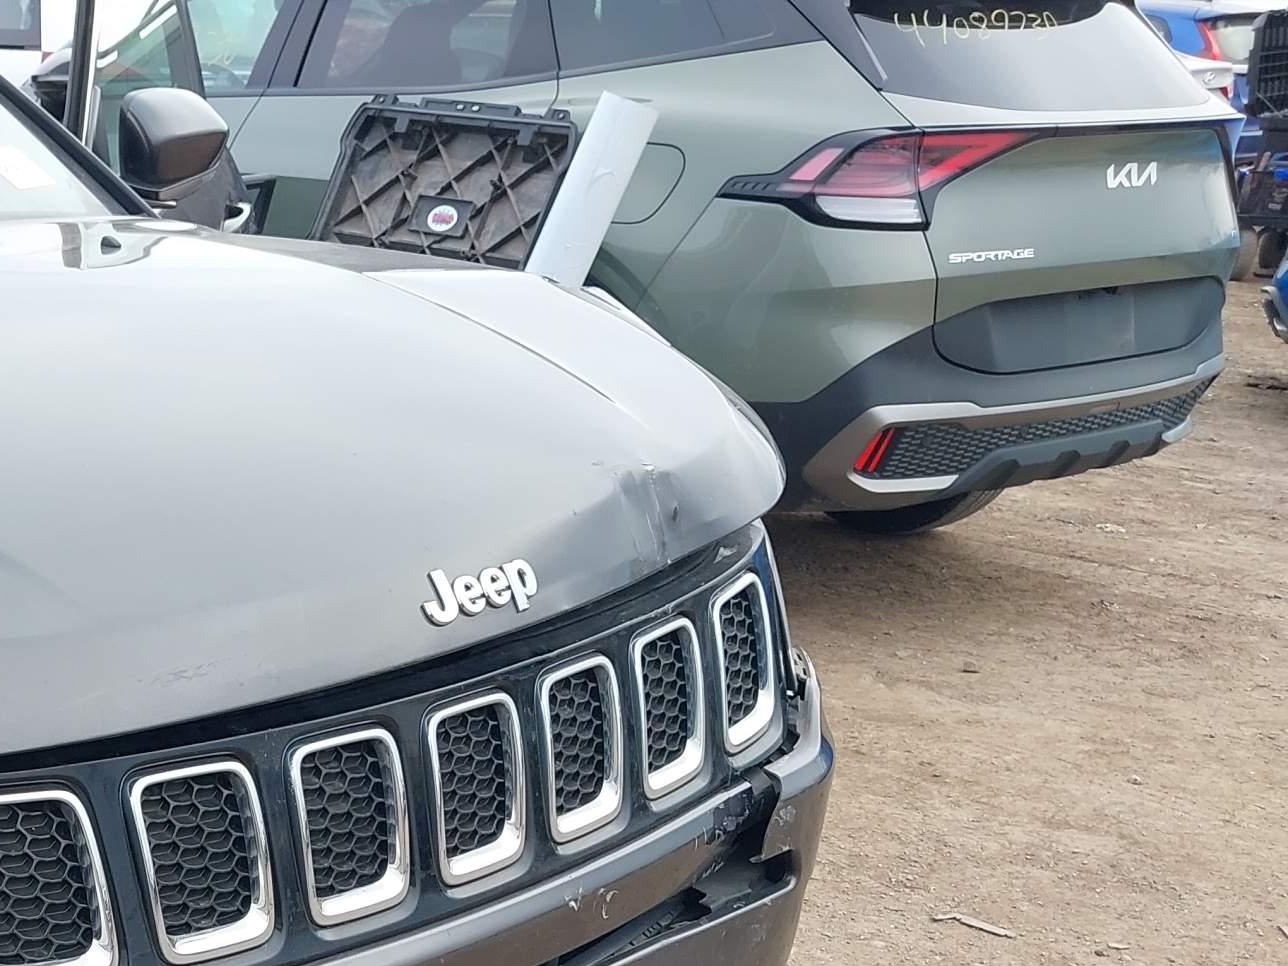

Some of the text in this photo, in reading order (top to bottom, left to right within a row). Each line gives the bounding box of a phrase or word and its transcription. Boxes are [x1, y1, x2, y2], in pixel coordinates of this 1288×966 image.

[1105, 161, 1158, 189] KIA
[947, 248, 1036, 264] SPORTAGE
[420, 558, 538, 627] Jeep
